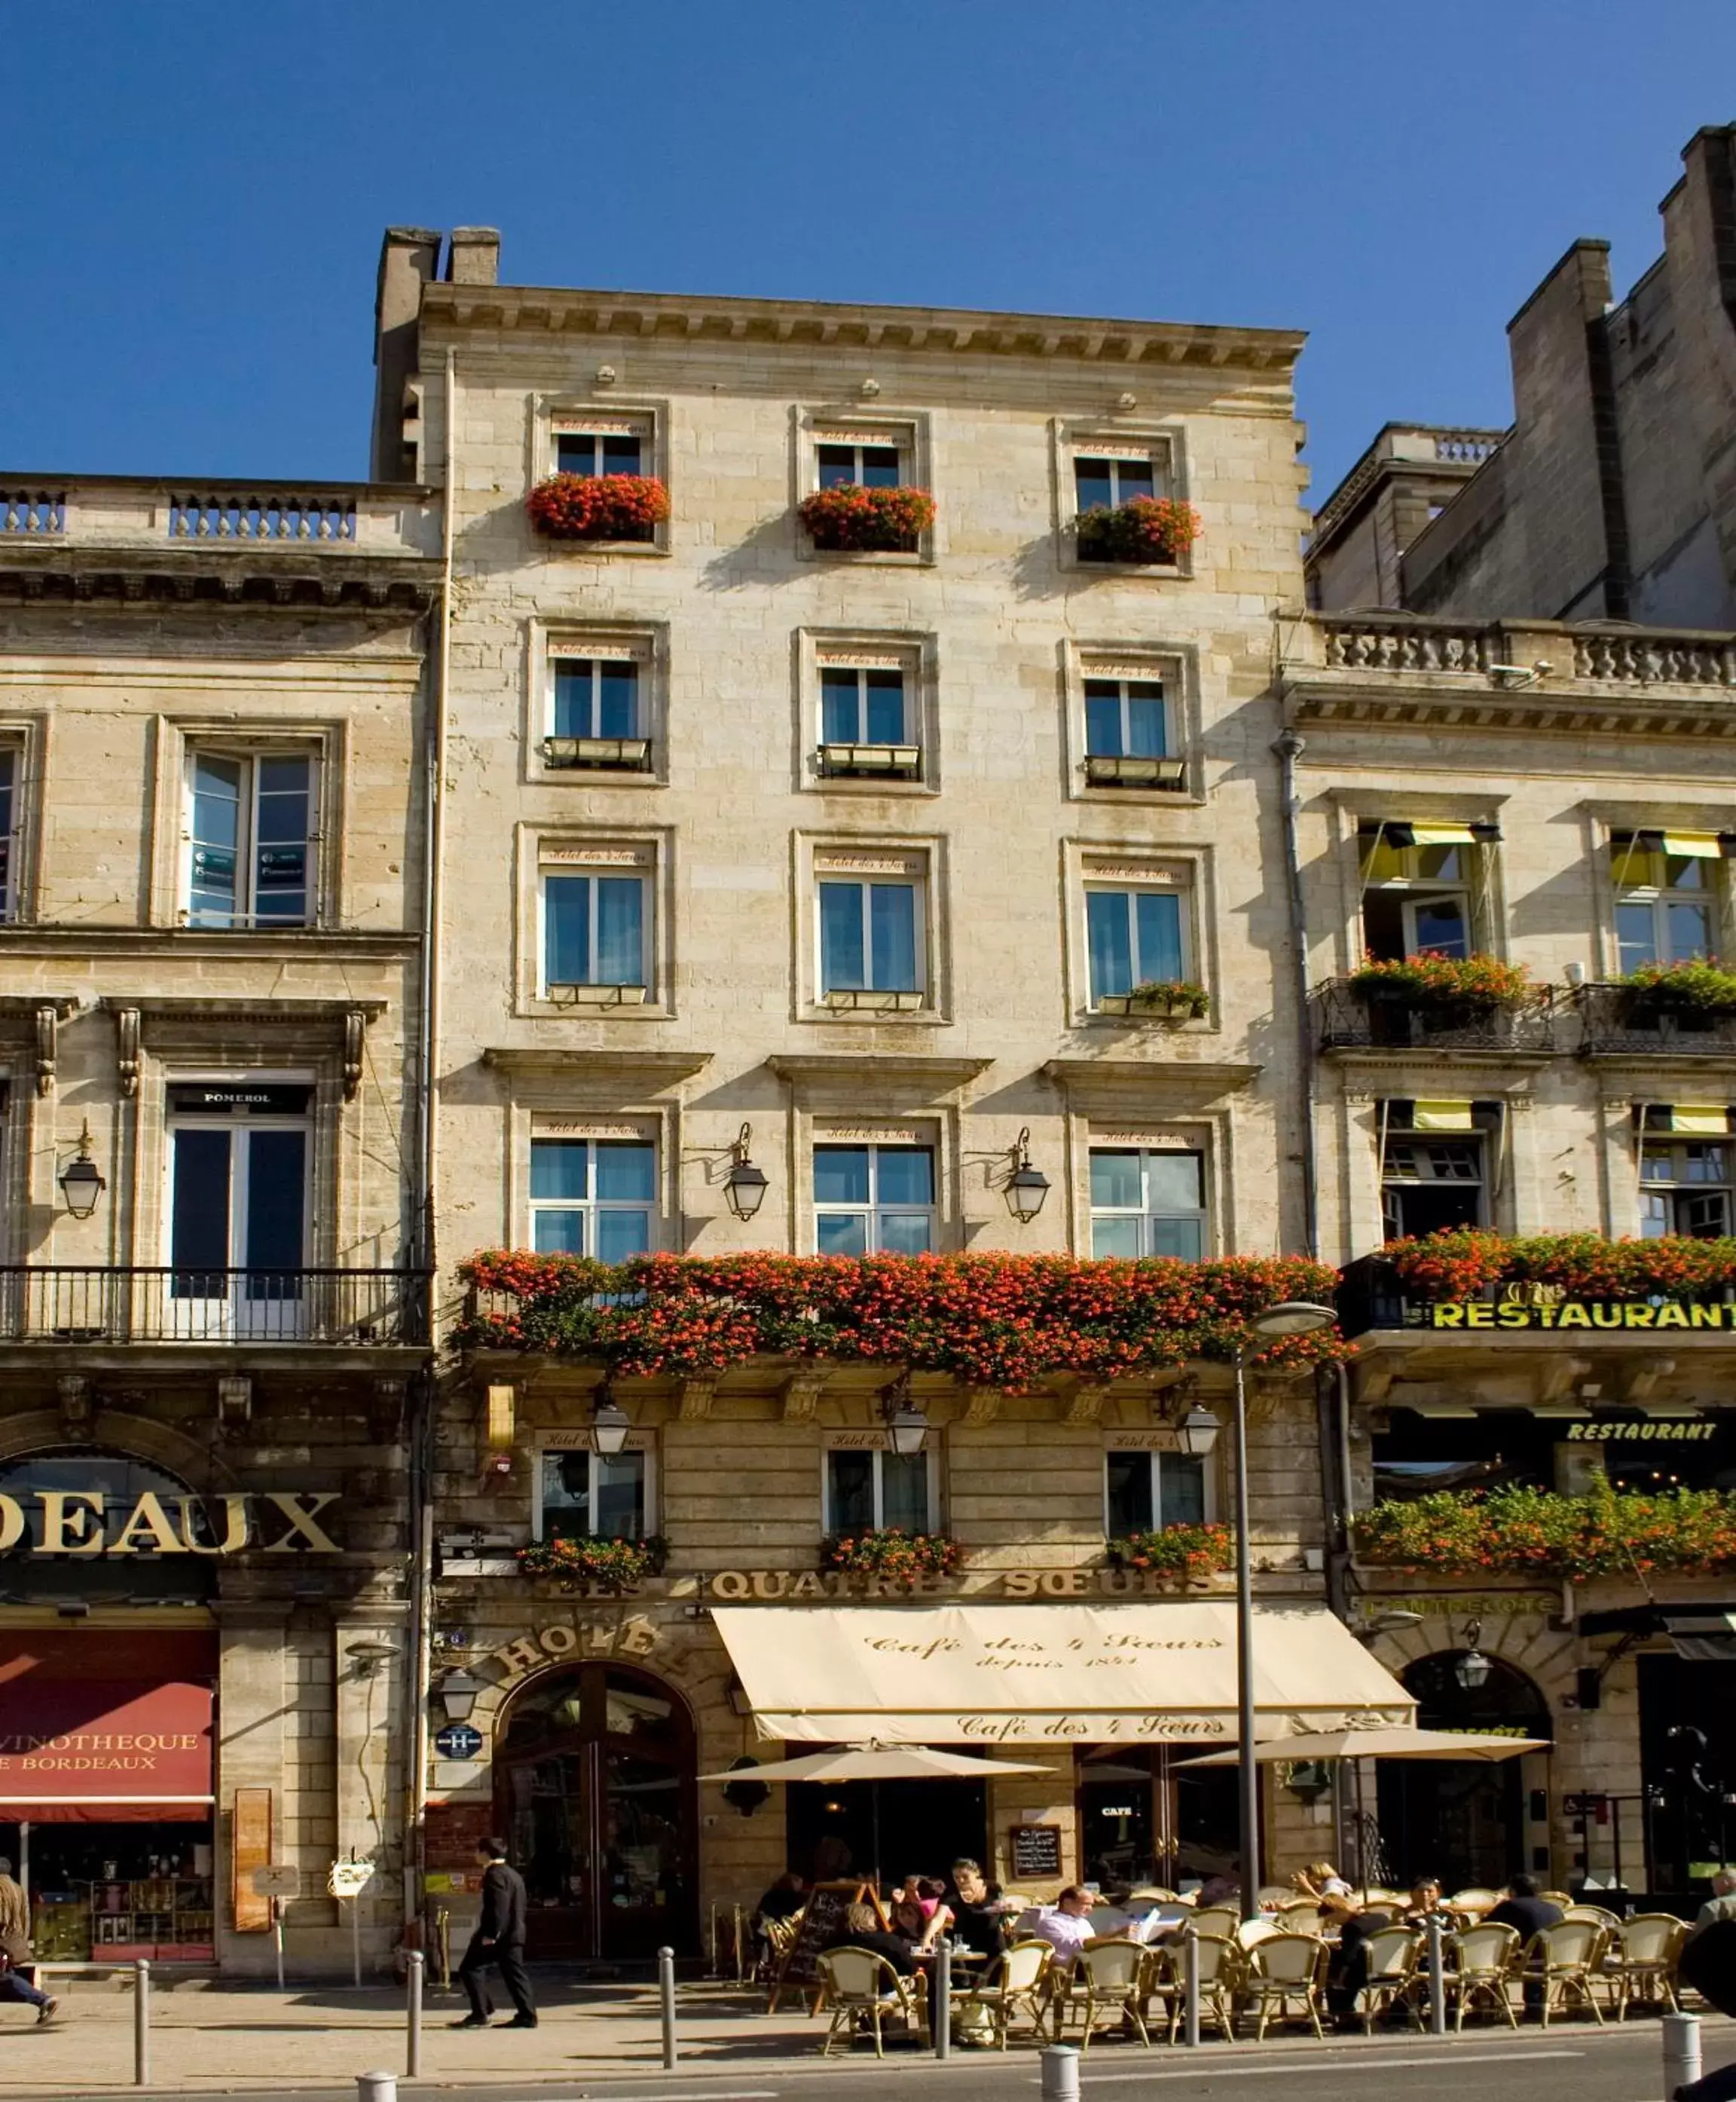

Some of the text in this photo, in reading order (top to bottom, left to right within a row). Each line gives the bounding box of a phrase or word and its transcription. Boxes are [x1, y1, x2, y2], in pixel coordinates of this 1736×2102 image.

[205, 1094, 271, 1103] POMEROL
[1567, 1423, 1716, 1440] RESTAURANT
[546, 1433, 579, 1446] Hôtel
[833, 1433, 885, 1446] Hôtel des
[1113, 1434, 1145, 1448] Hôtel
[1147, 1434, 1164, 1448] des
[711, 1570, 952, 1599] QUATRE
[863, 1637, 963, 1660] Café
[983, 1637, 1044, 1651] des
[1067, 1638, 1083, 1651] 4
[974, 1656, 1064, 1670] depuis
[957, 1716, 1027, 1741] Café
[1044, 1716, 1087, 1735] des
[1106, 1718, 1121, 1735] 4
[451, 1734, 467, 1749] H
[22, 1757, 157, 1770] BORDEAUX
[1102, 1807, 1132, 1816] CAFE
